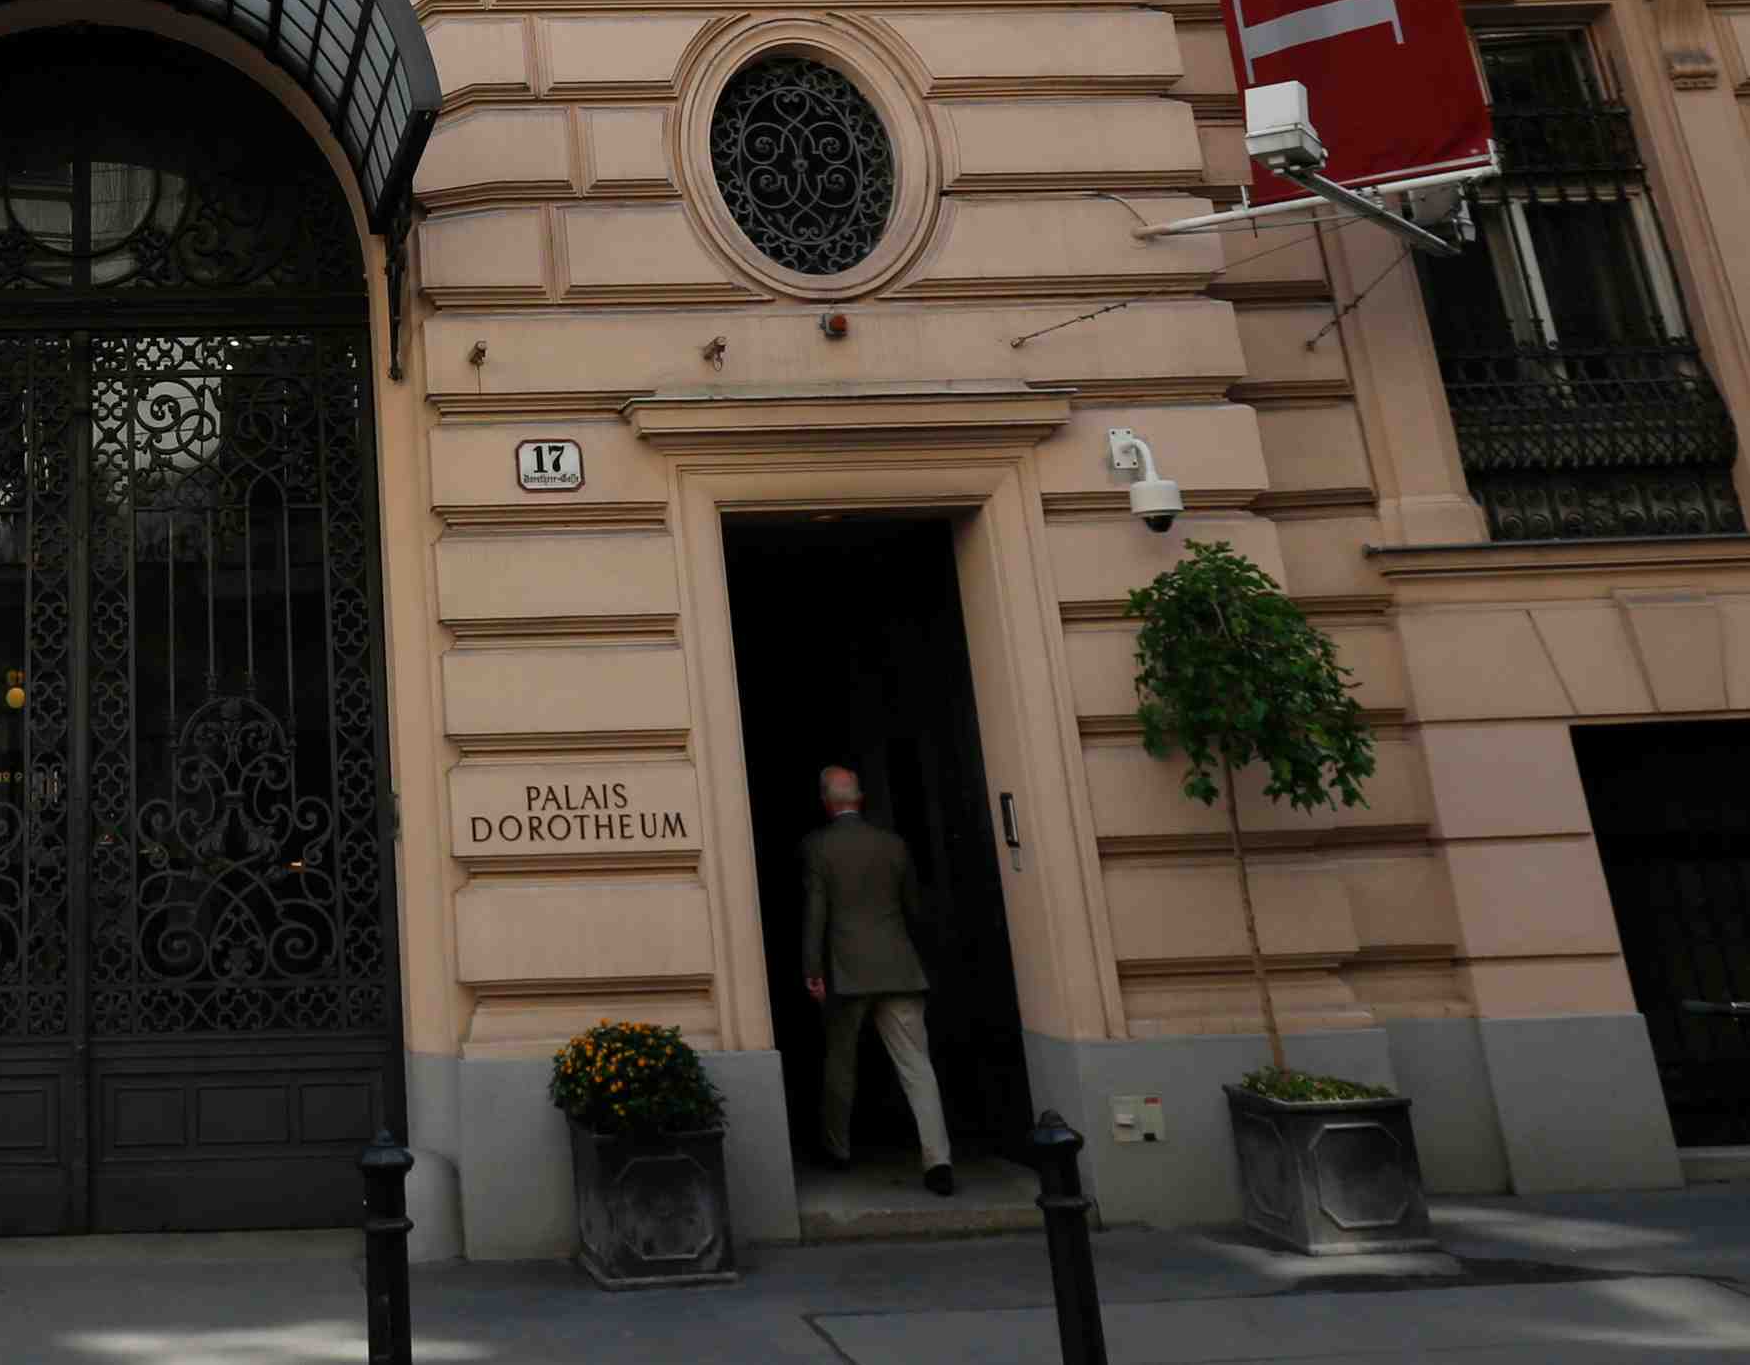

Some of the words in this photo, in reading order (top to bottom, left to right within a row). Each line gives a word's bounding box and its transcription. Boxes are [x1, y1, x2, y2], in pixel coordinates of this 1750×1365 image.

[533, 445, 565, 473] 17
[526, 783, 628, 811] PALAIS
[471, 812, 687, 842] DOROTHEUM
